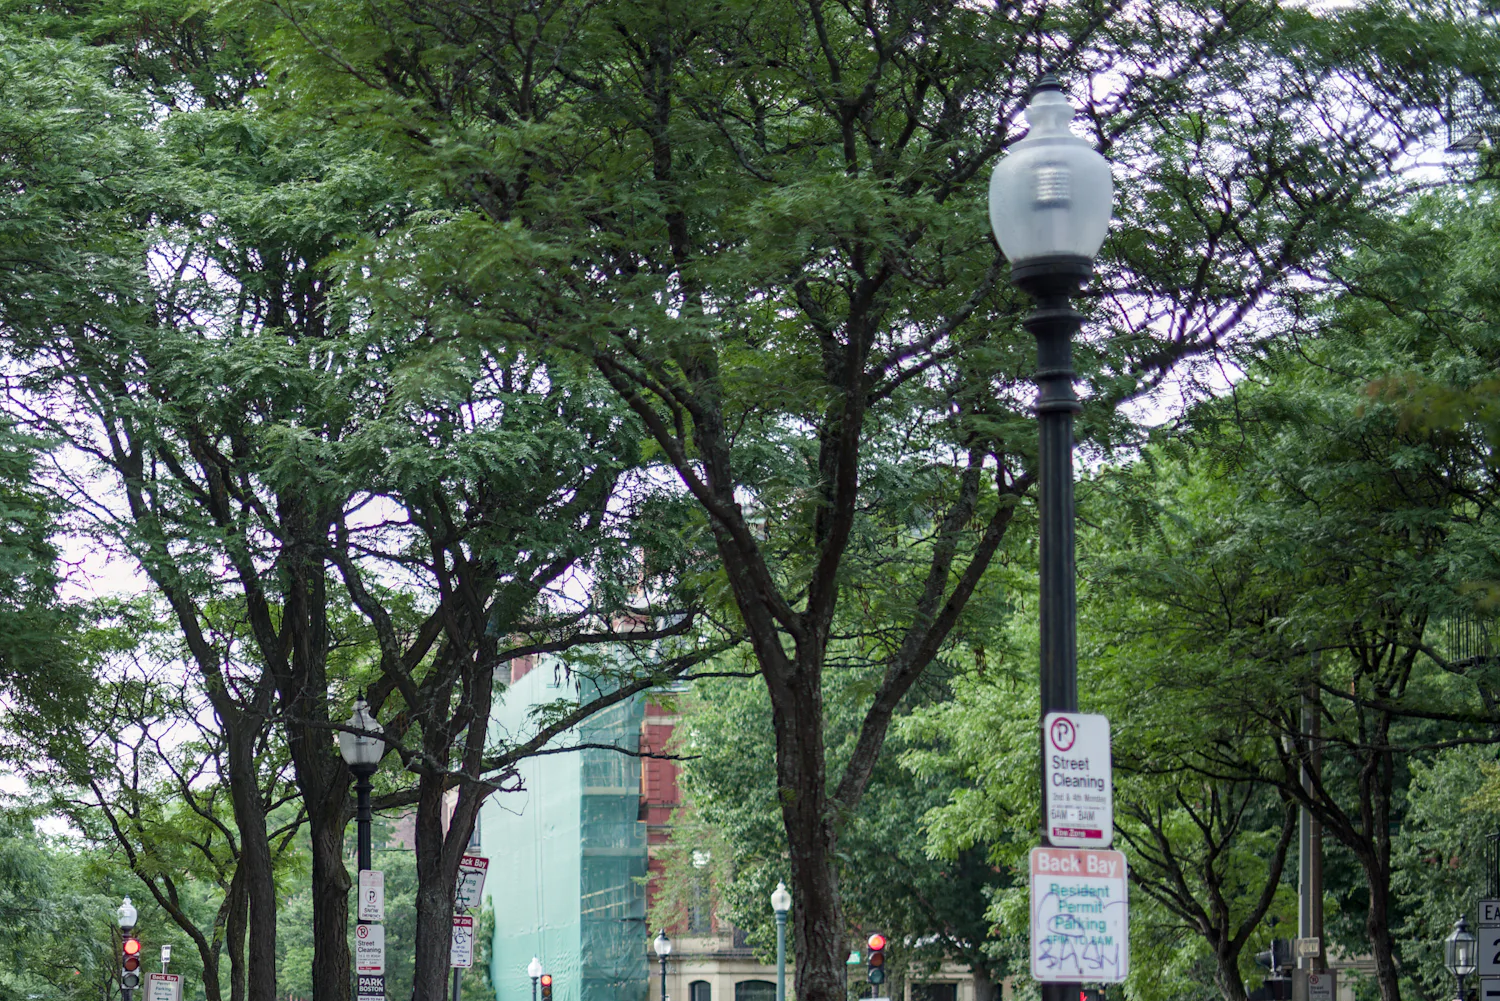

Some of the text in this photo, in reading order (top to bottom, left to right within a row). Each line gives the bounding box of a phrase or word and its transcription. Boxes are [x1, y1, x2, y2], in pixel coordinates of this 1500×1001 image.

[1052, 755, 1090, 770] Street
[1053, 772, 1105, 791] Cleaning
[475, 859, 487, 868] Bay
[1038, 853, 1117, 877] Back Bay
[1050, 883, 1110, 898] Resident
[1059, 900, 1103, 913] Permit
[1055, 916, 1107, 933] Parking
[359, 978, 383, 986] PARK
